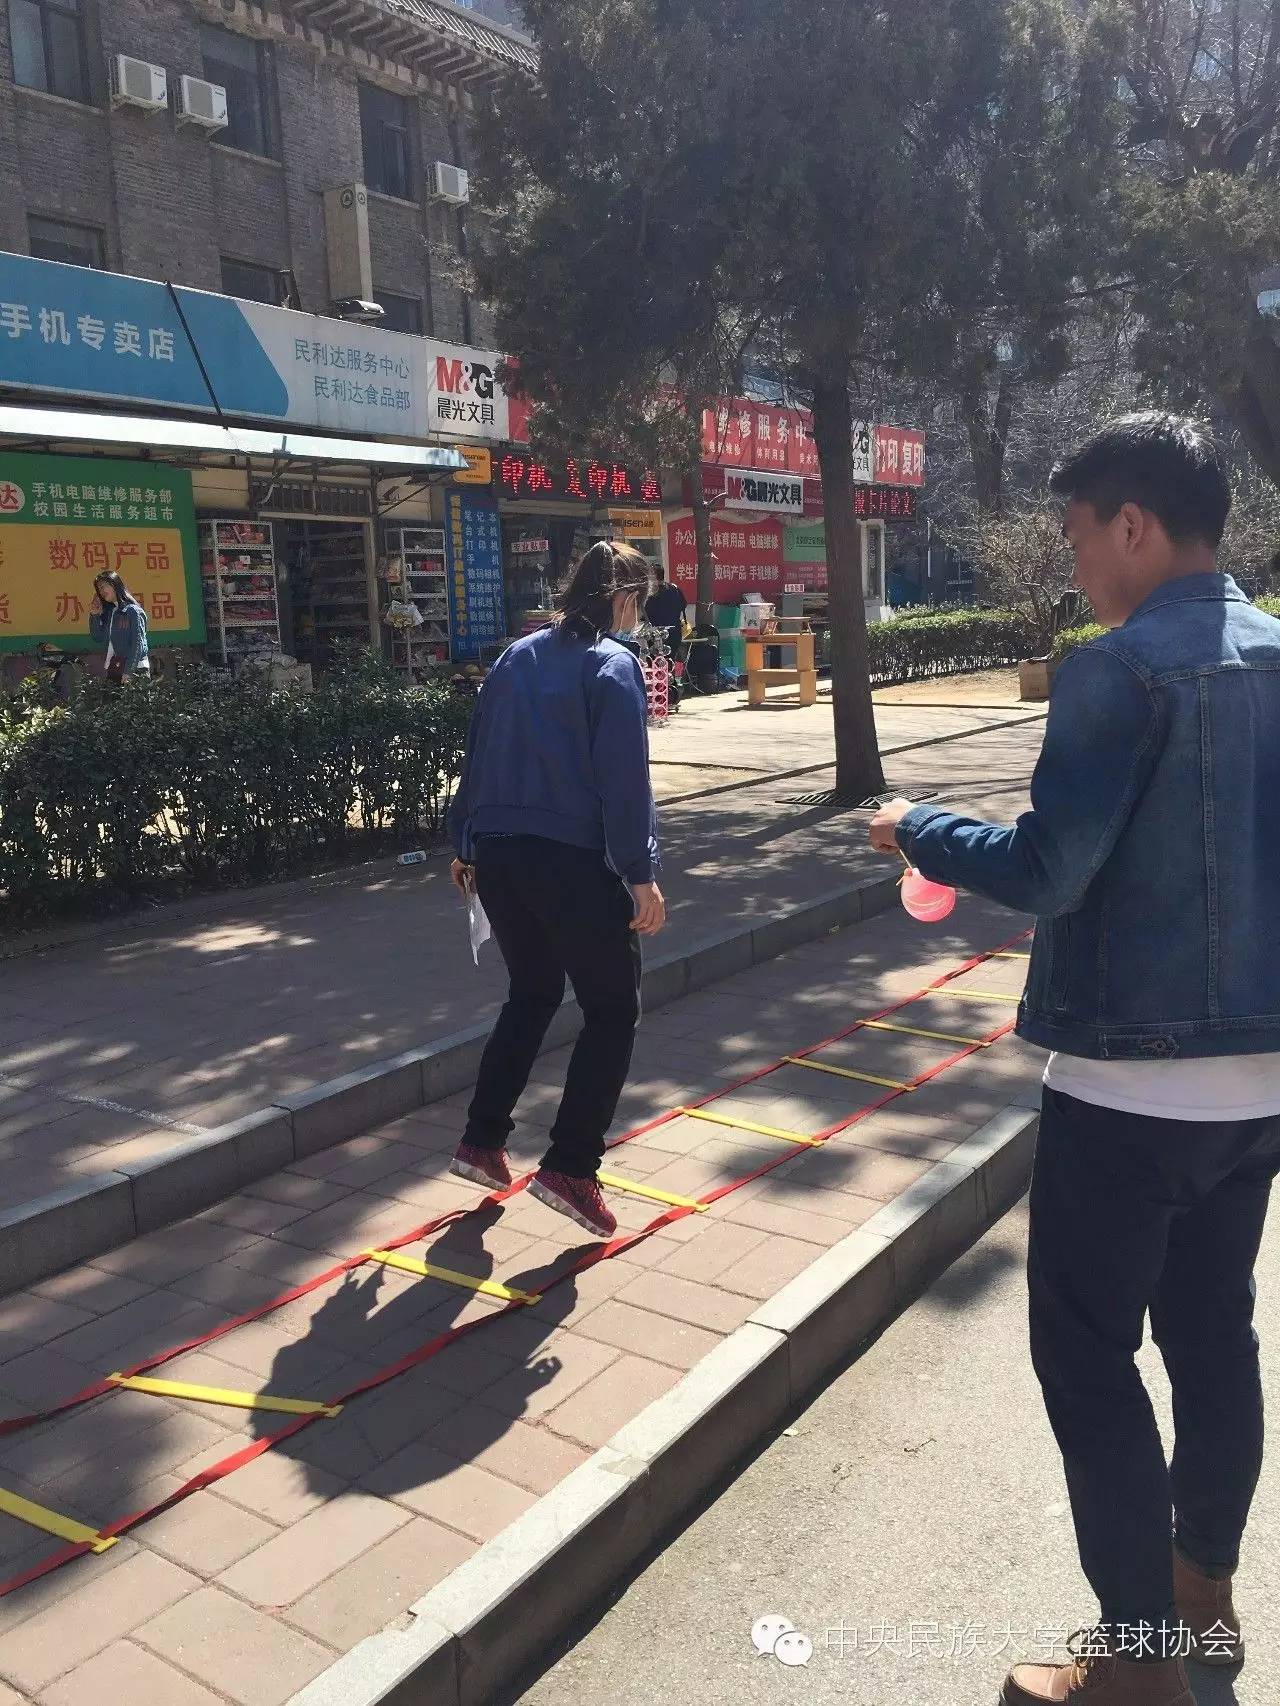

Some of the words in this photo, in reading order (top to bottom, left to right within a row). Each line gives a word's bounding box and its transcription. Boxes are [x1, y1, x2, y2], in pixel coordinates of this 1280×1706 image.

[0, 302, 174, 362] 手机专卖店
[295, 338, 409, 379] 民利达服务中心
[314, 376, 411, 412] 民利达食品部
[436, 356, 494, 399] M&G
[438, 397, 494, 425] 晨光文具
[702, 407, 816, 447] 维修服务中
[874, 434, 898, 473] 打印
[902, 440, 924, 476] 复印
[32, 482, 173, 504] 手机电脑维修服务部
[33, 501, 174, 521] 校园生活服务超市
[49, 540, 171, 571] 数码产品
[56, 592, 175, 623] 办品
